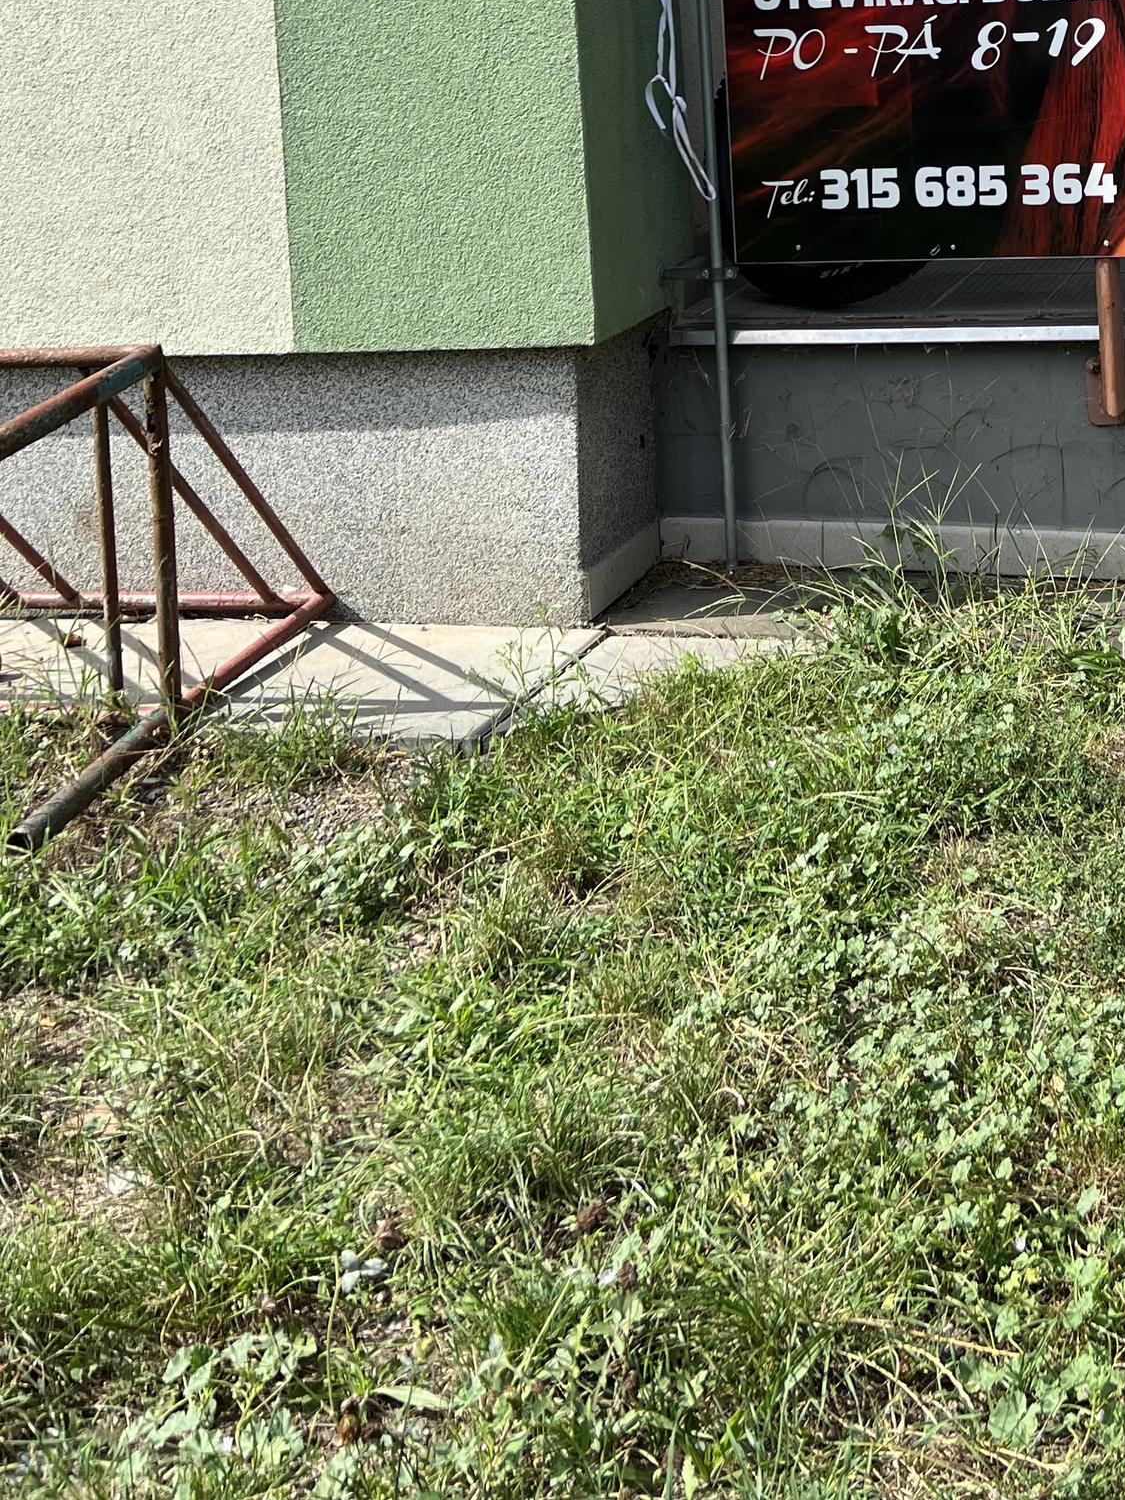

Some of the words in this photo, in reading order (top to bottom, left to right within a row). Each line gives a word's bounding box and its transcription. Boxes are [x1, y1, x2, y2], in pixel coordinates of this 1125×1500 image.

[753, 28, 826, 80] PO
[864, 15, 942, 77] PÁ
[820, 168, 900, 210] 315
[915, 165, 1008, 208] 685
[1021, 163, 1118, 206] 364
